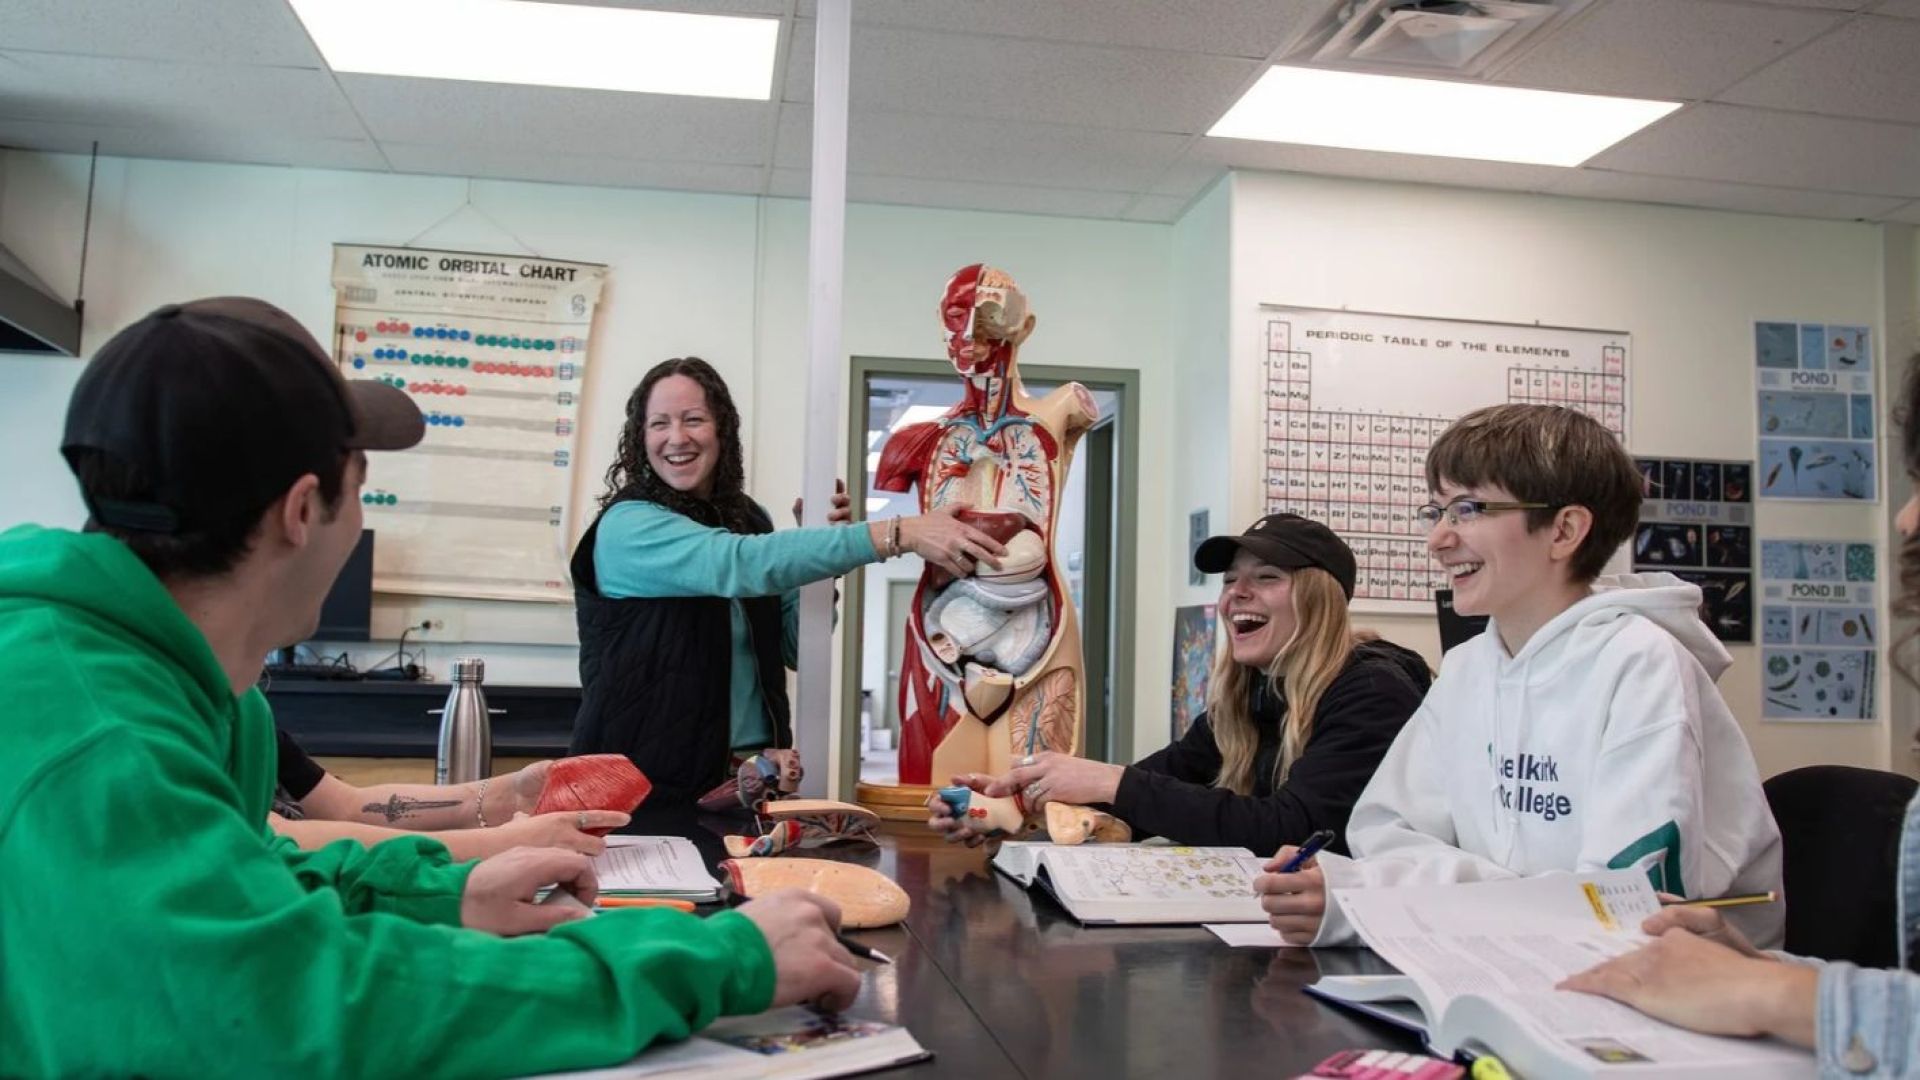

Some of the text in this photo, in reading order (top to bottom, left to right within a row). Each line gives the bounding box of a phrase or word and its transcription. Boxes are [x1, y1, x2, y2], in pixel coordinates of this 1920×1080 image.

[362, 253, 578, 282] ATOMIC ORBITAL CHART
[501, 296, 547, 305] COMPANY
[1306, 330, 1570, 357] PERIODIC TABLE OF THE ELEMENTS
[1273, 361, 1308, 370] Li Be
[1514, 377, 1523, 385] B
[1534, 379, 1542, 387] C
[1791, 371, 1830, 385] POND
[1832, 373, 1838, 385] I
[1270, 390, 1310, 401] Na Mg
[1356, 424, 1365, 432] V
[1374, 425, 1388, 433] Cr
[1390, 426, 1411, 434] Mn
[1269, 448, 1285, 456] Rb
[1291, 449, 1306, 457] Sr
[1315, 451, 1323, 459] Y
[1333, 452, 1346, 460] Zr
[1352, 453, 1369, 461] Nb
[1371, 454, 1390, 462] Mo
[1394, 455, 1407, 463] Tc
[1270, 478, 1285, 486] Cs
[1290, 479, 1306, 487] Ba
[1311, 480, 1326, 488] La
[1332, 481, 1346, 489] Hf
[1353, 482, 1367, 491] Ta
[1310, 509, 1326, 517] Ac
[1666, 502, 1707, 516] POND
[1709, 505, 1719, 517] II
[1370, 548, 1390, 556] Pm
[1412, 550, 1427, 558] Eu
[1370, 578, 1388, 587] Np
[1391, 579, 1407, 587] Pu
[1792, 583, 1831, 597] POND
[1833, 584, 1847, 598] III
